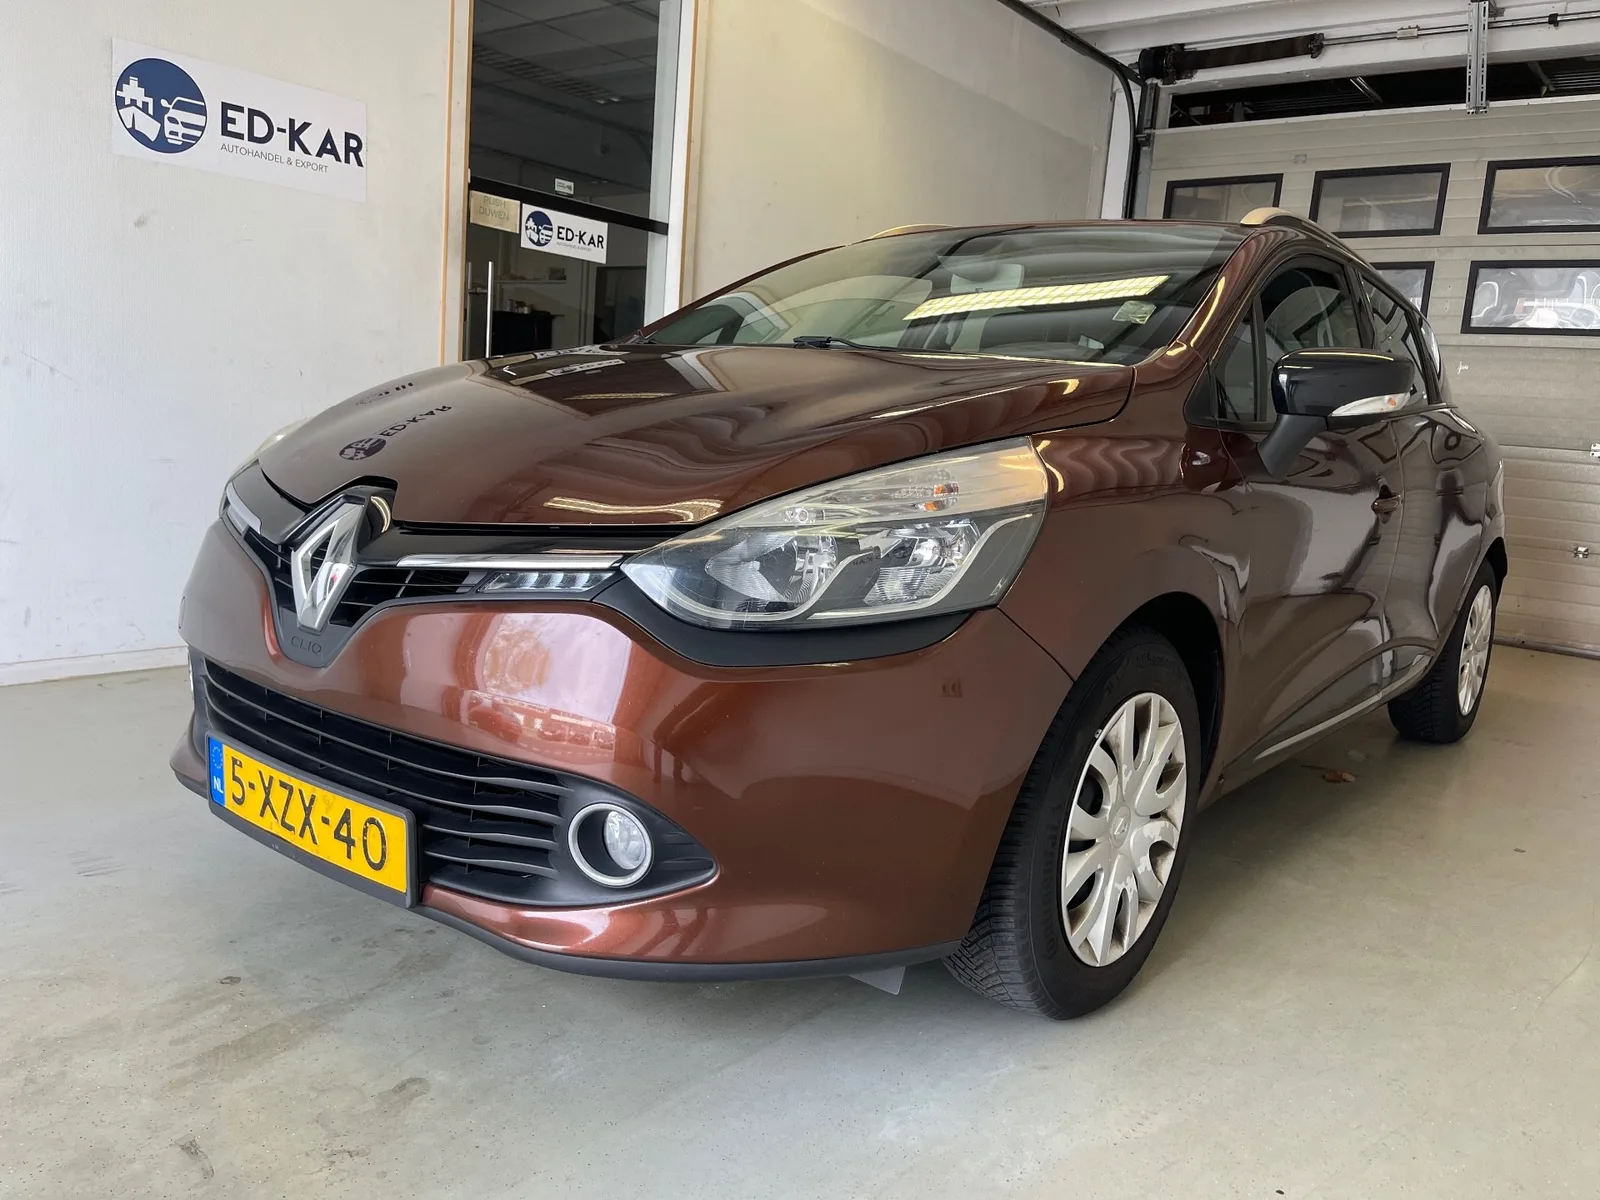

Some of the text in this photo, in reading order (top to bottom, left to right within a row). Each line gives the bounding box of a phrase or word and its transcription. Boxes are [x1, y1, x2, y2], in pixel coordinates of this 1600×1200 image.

[221, 101, 364, 168] ED-KAR
[220, 143, 328, 173] AUTOHANDEL & EXPORT
[557, 225, 604, 249] ED-KAR
[291, 635, 322, 655] CLIO
[213, 775, 224, 794] NL
[230, 756, 388, 871] 5-XZX-40
